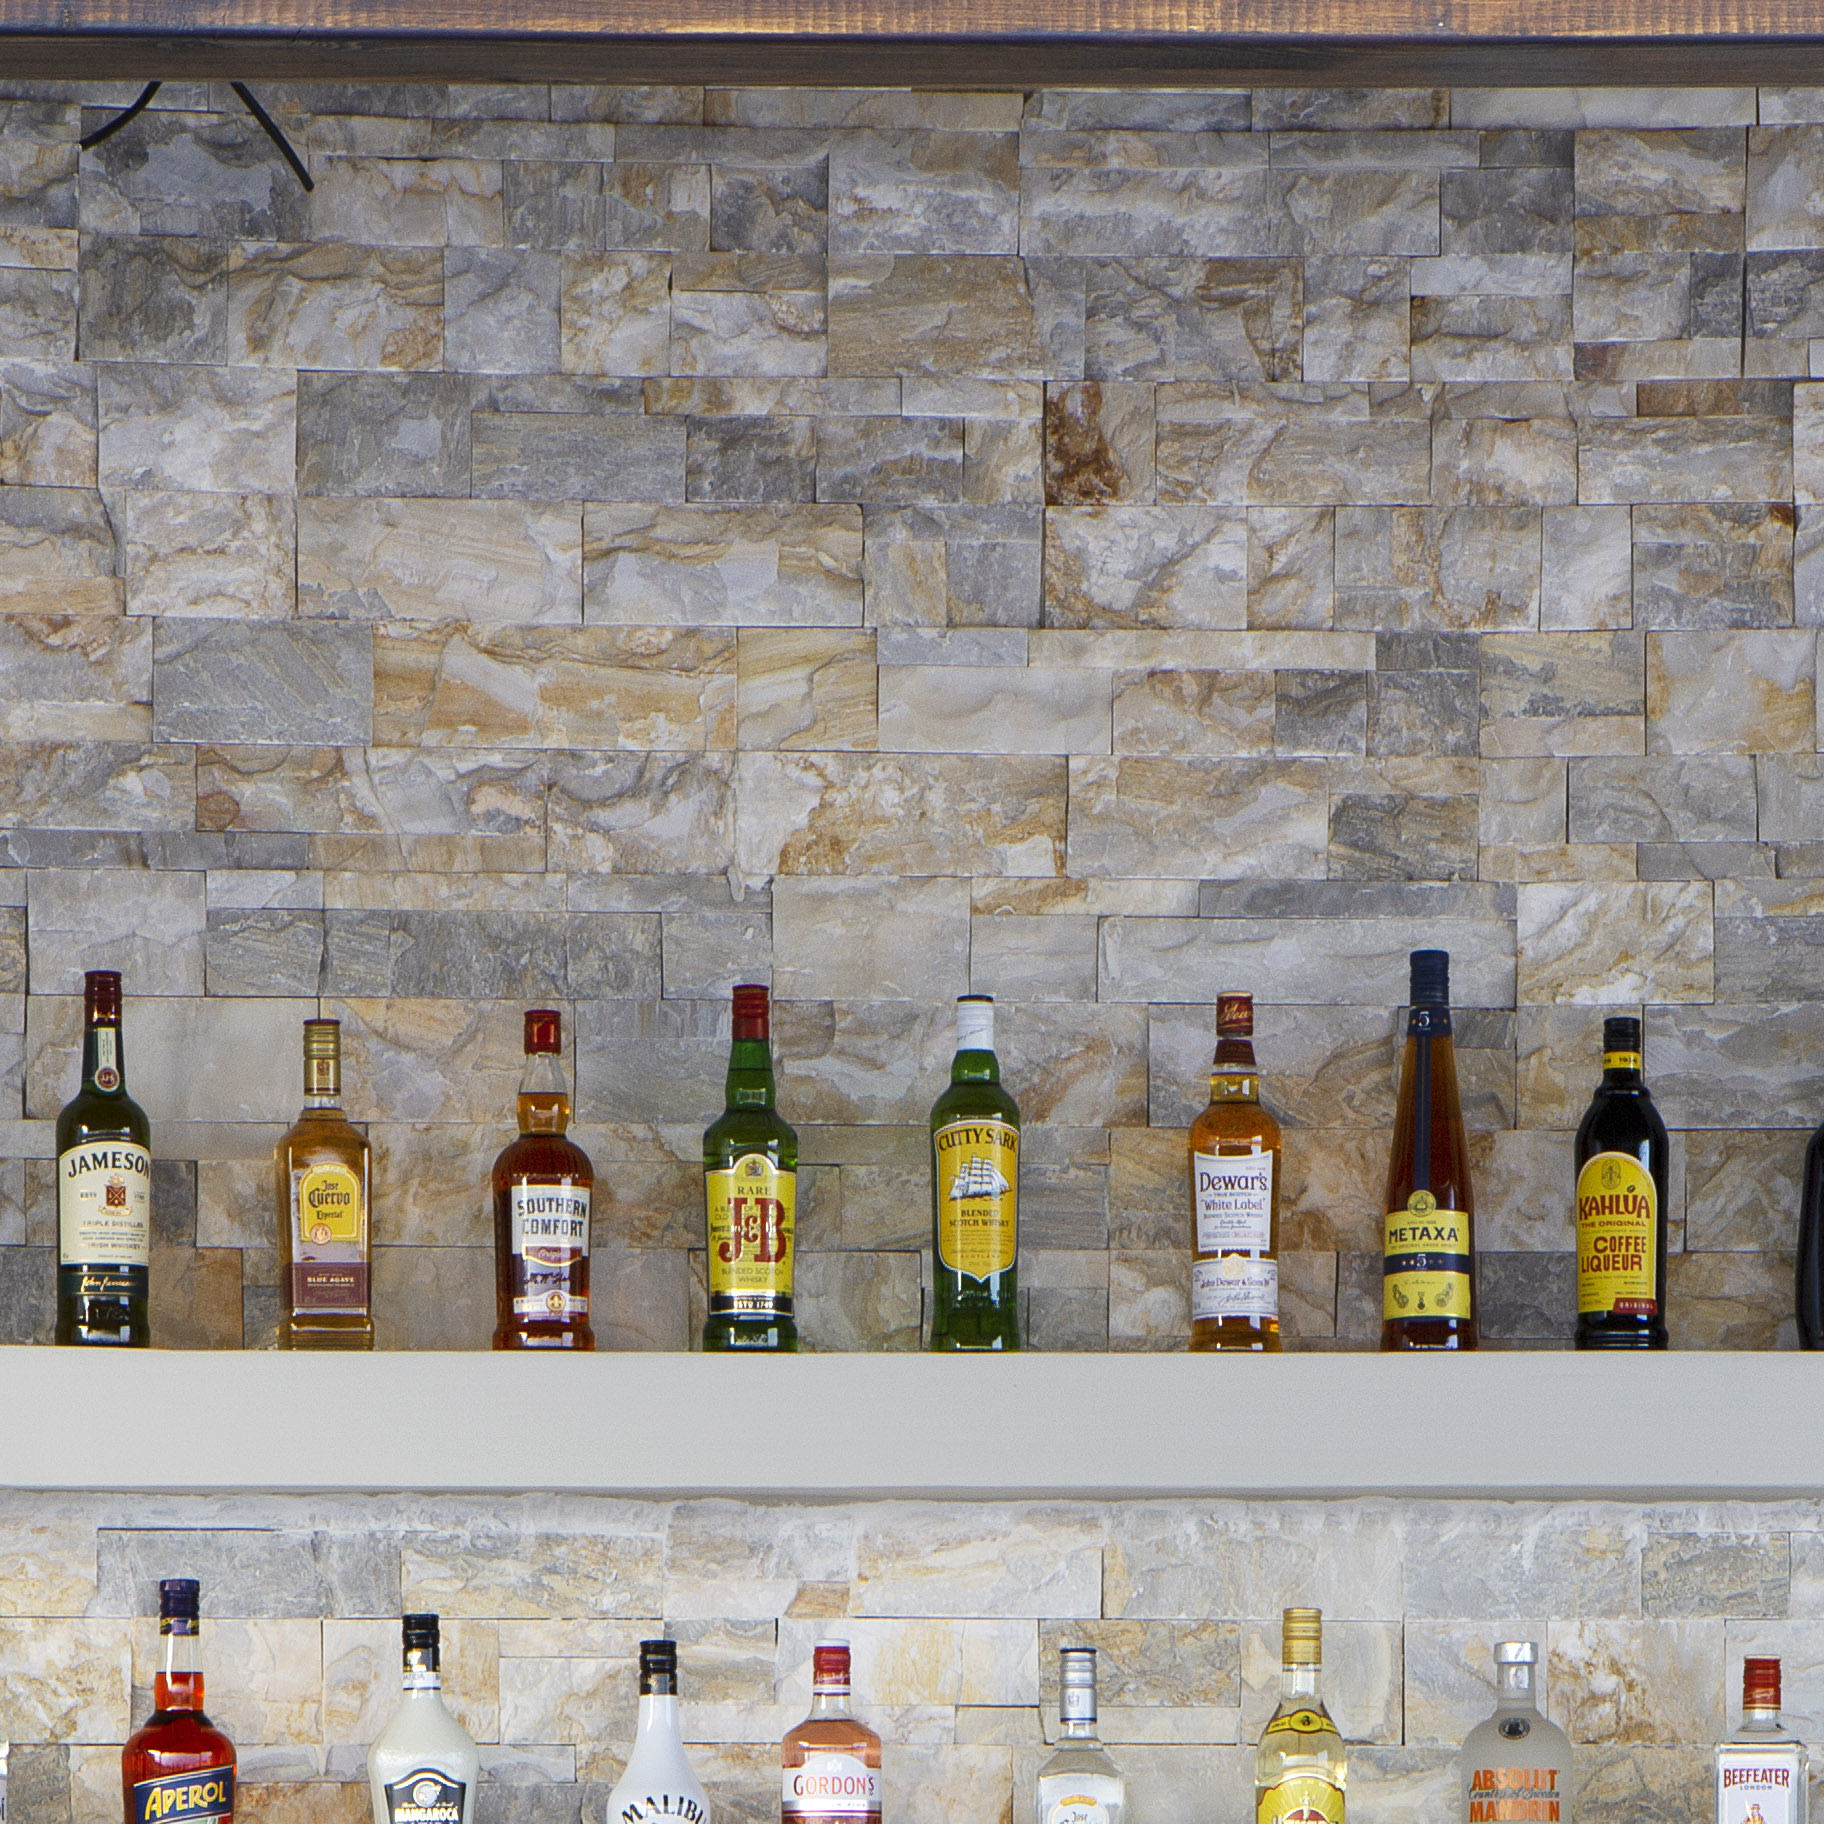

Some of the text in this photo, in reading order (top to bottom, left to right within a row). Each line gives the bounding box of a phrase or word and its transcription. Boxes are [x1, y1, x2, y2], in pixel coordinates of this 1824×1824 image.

[1418, 1011, 1431, 1028] 5
[938, 1128, 1016, 1153] CUTTY SARK
[1199, 1171, 1268, 1193] Dewar's
[309, 1187, 351, 1208] Cuervo
[517, 1197, 587, 1219] SOUTHERN
[524, 1218, 584, 1238] COMFORT
[718, 1197, 787, 1263] J&B
[1389, 1226, 1458, 1244] METAXA
[1581, 1220, 1647, 1229] THE ORIGINAL
[1593, 1235, 1647, 1255] COFFEE
[1581, 1254, 1643, 1274] LIQUEUR
[1471, 1768, 1559, 1791] ABSOLUT
[1723, 1768, 1790, 1789] BEEFEATER
[144, 1780, 226, 1821] APEROL
[1469, 1800, 1560, 1823] MANDRIN
